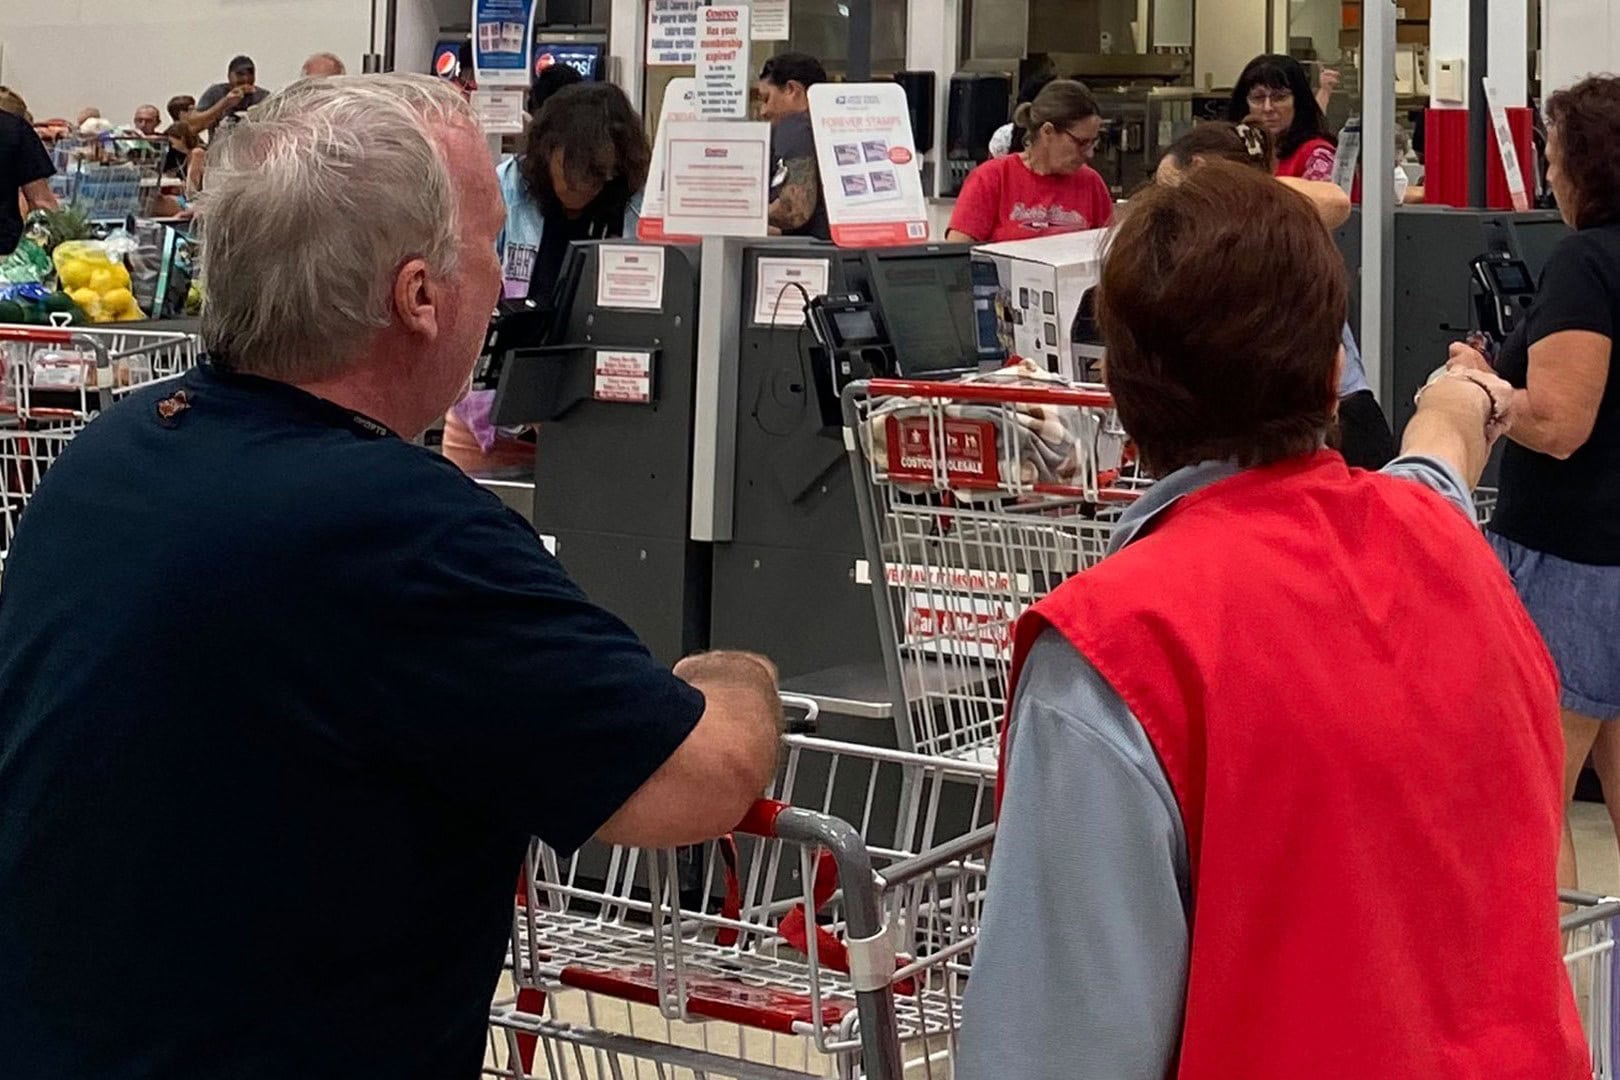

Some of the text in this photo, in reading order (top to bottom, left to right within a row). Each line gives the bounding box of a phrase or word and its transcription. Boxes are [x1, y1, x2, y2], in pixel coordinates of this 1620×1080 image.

[721, 27, 737, 38] your
[700, 39, 743, 50] membership
[705, 50, 736, 62] expired?
[942, 459, 985, 475] OLESALE
